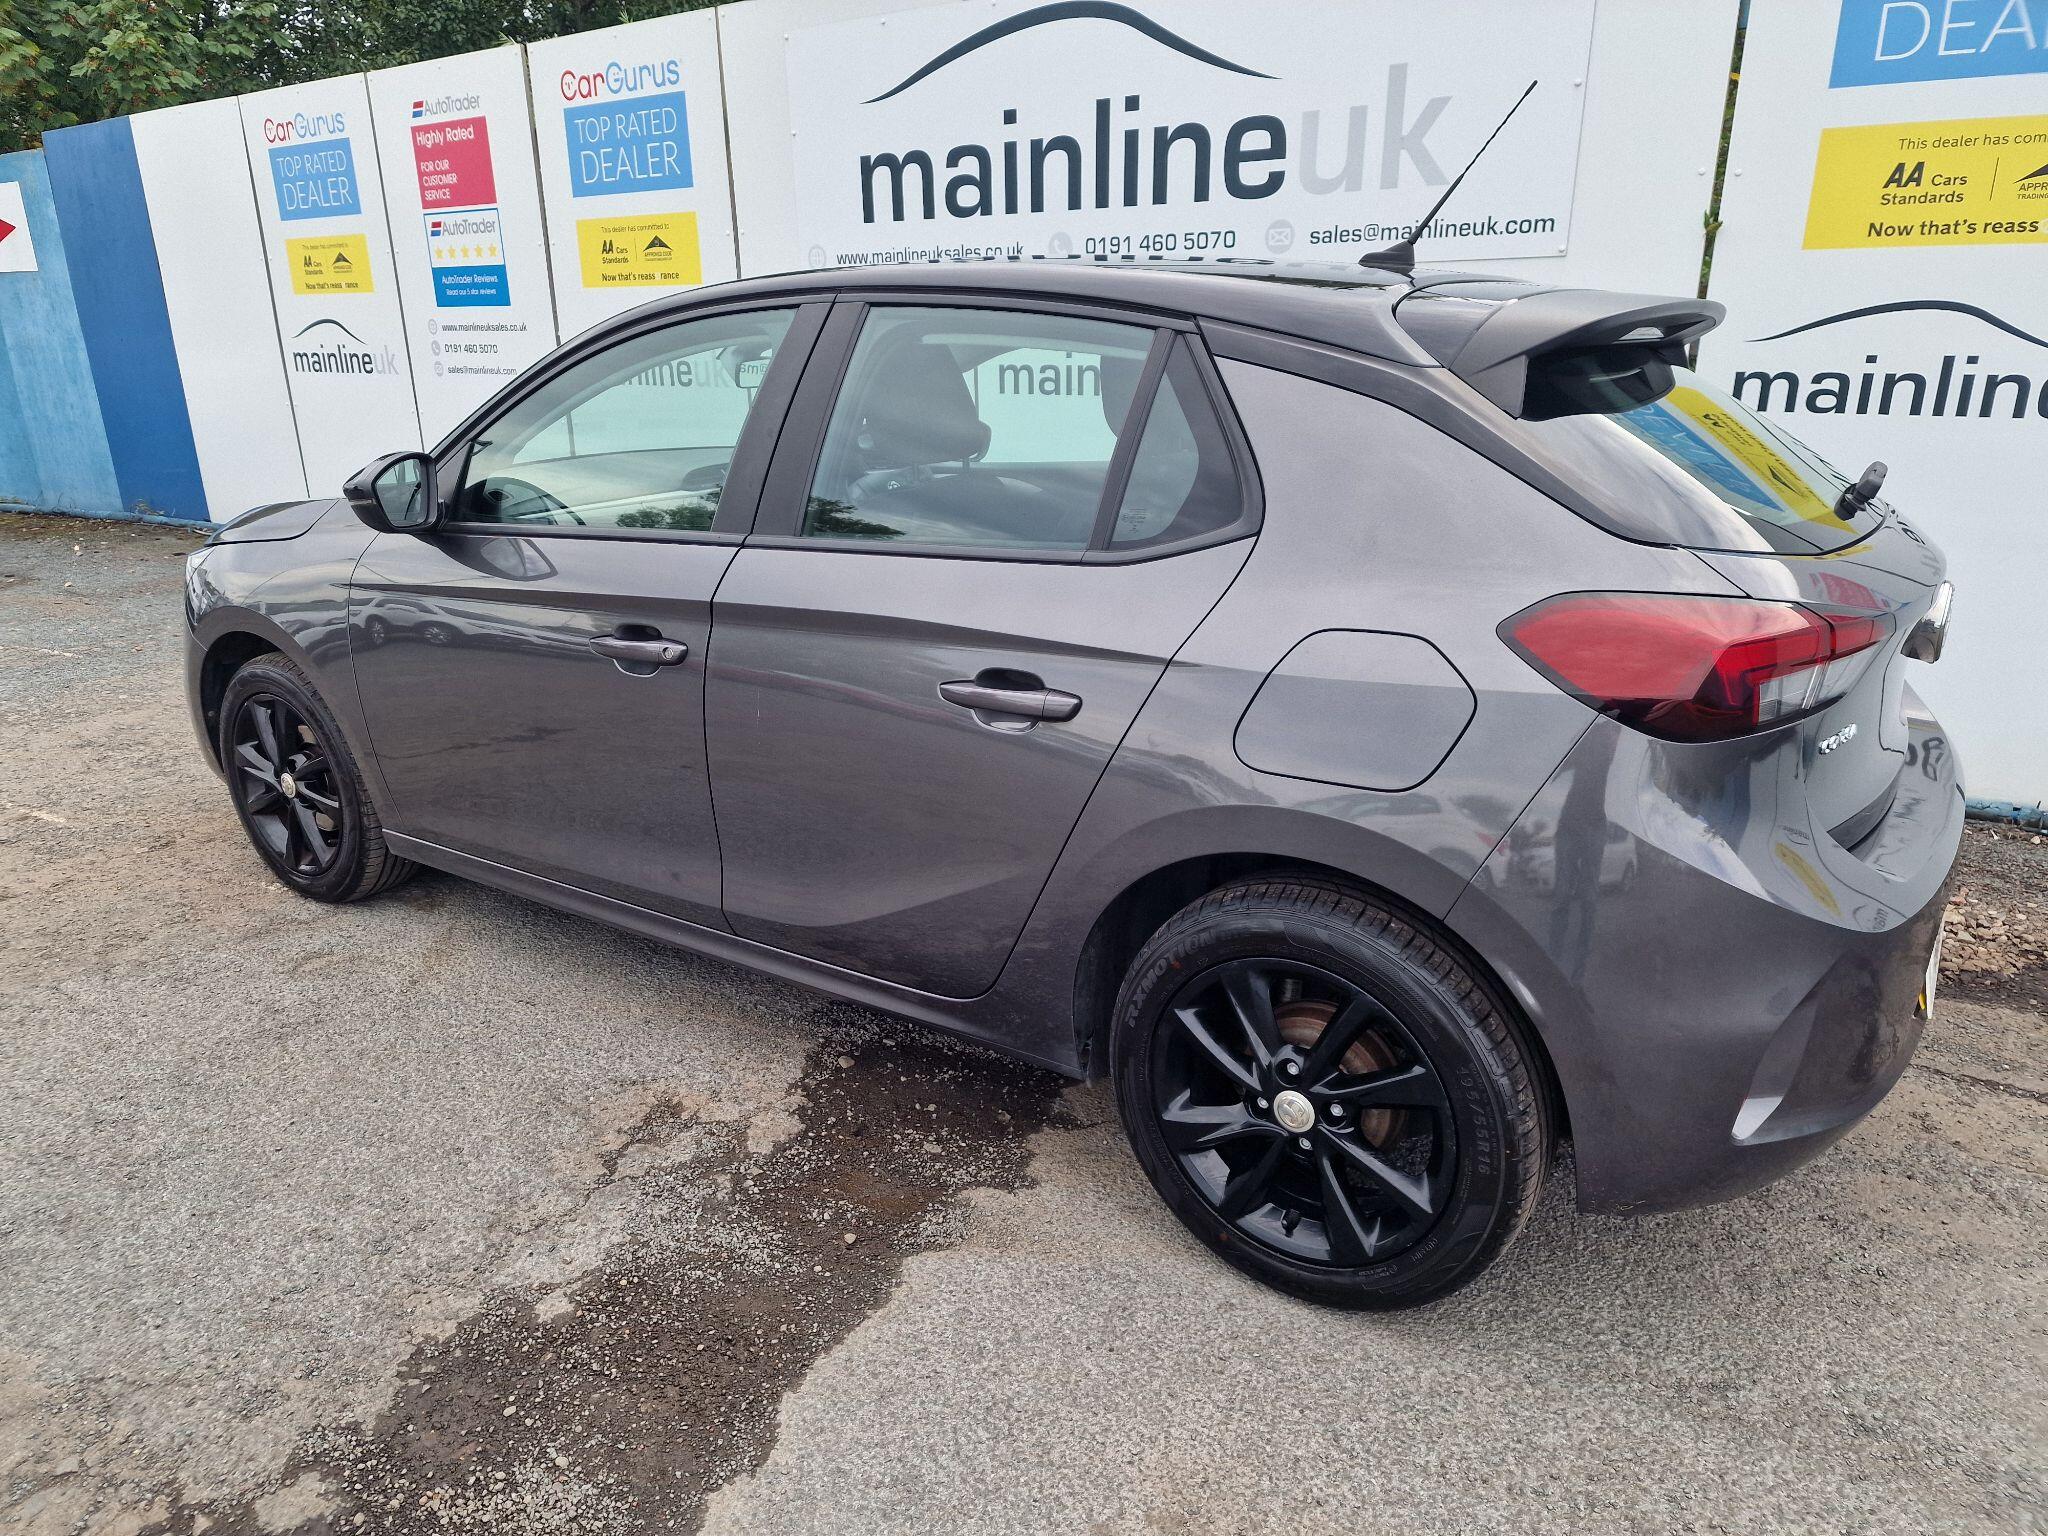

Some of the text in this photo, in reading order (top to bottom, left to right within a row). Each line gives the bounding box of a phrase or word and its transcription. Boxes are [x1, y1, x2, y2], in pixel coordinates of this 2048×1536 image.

[560, 59, 681, 101] CarGurus
[424, 93, 480, 117] AutoTrader
[263, 112, 345, 144] CarGurus
[416, 124, 475, 149] Highly Rated
[574, 107, 677, 144] TOP RATED
[859, 61, 1456, 224] mainlineuk
[1899, 133, 2048, 150] This dealer has com
[275, 150, 347, 178] TOP RATED
[420, 159, 450, 172] FOR OUR
[580, 141, 681, 184] DEALER
[422, 172, 458, 187] CUSTOMER
[1881, 161, 1968, 189] AA Cars
[282, 176, 353, 211] DEALER
[424, 188, 451, 201] SERVICE
[1880, 191, 1965, 206] Standards
[441, 217, 497, 237] AutoTrader
[1867, 219, 2048, 238] Now that's reass
[602, 239, 629, 255] AA Cars
[836, 241, 1024, 265] www.mainlineuksales.couk
[1085, 230, 1236, 254] 0191 460 5070
[303, 255, 313, 268] AA
[602, 256, 629, 265] Standards
[441, 273, 499, 285] AutoTrader Reviews
[601, 272, 617, 282] Now
[293, 343, 400, 376] mainlineuk
[444, 343, 499, 354] 0191 460 5070
[1731, 354, 2048, 420] mainlin
